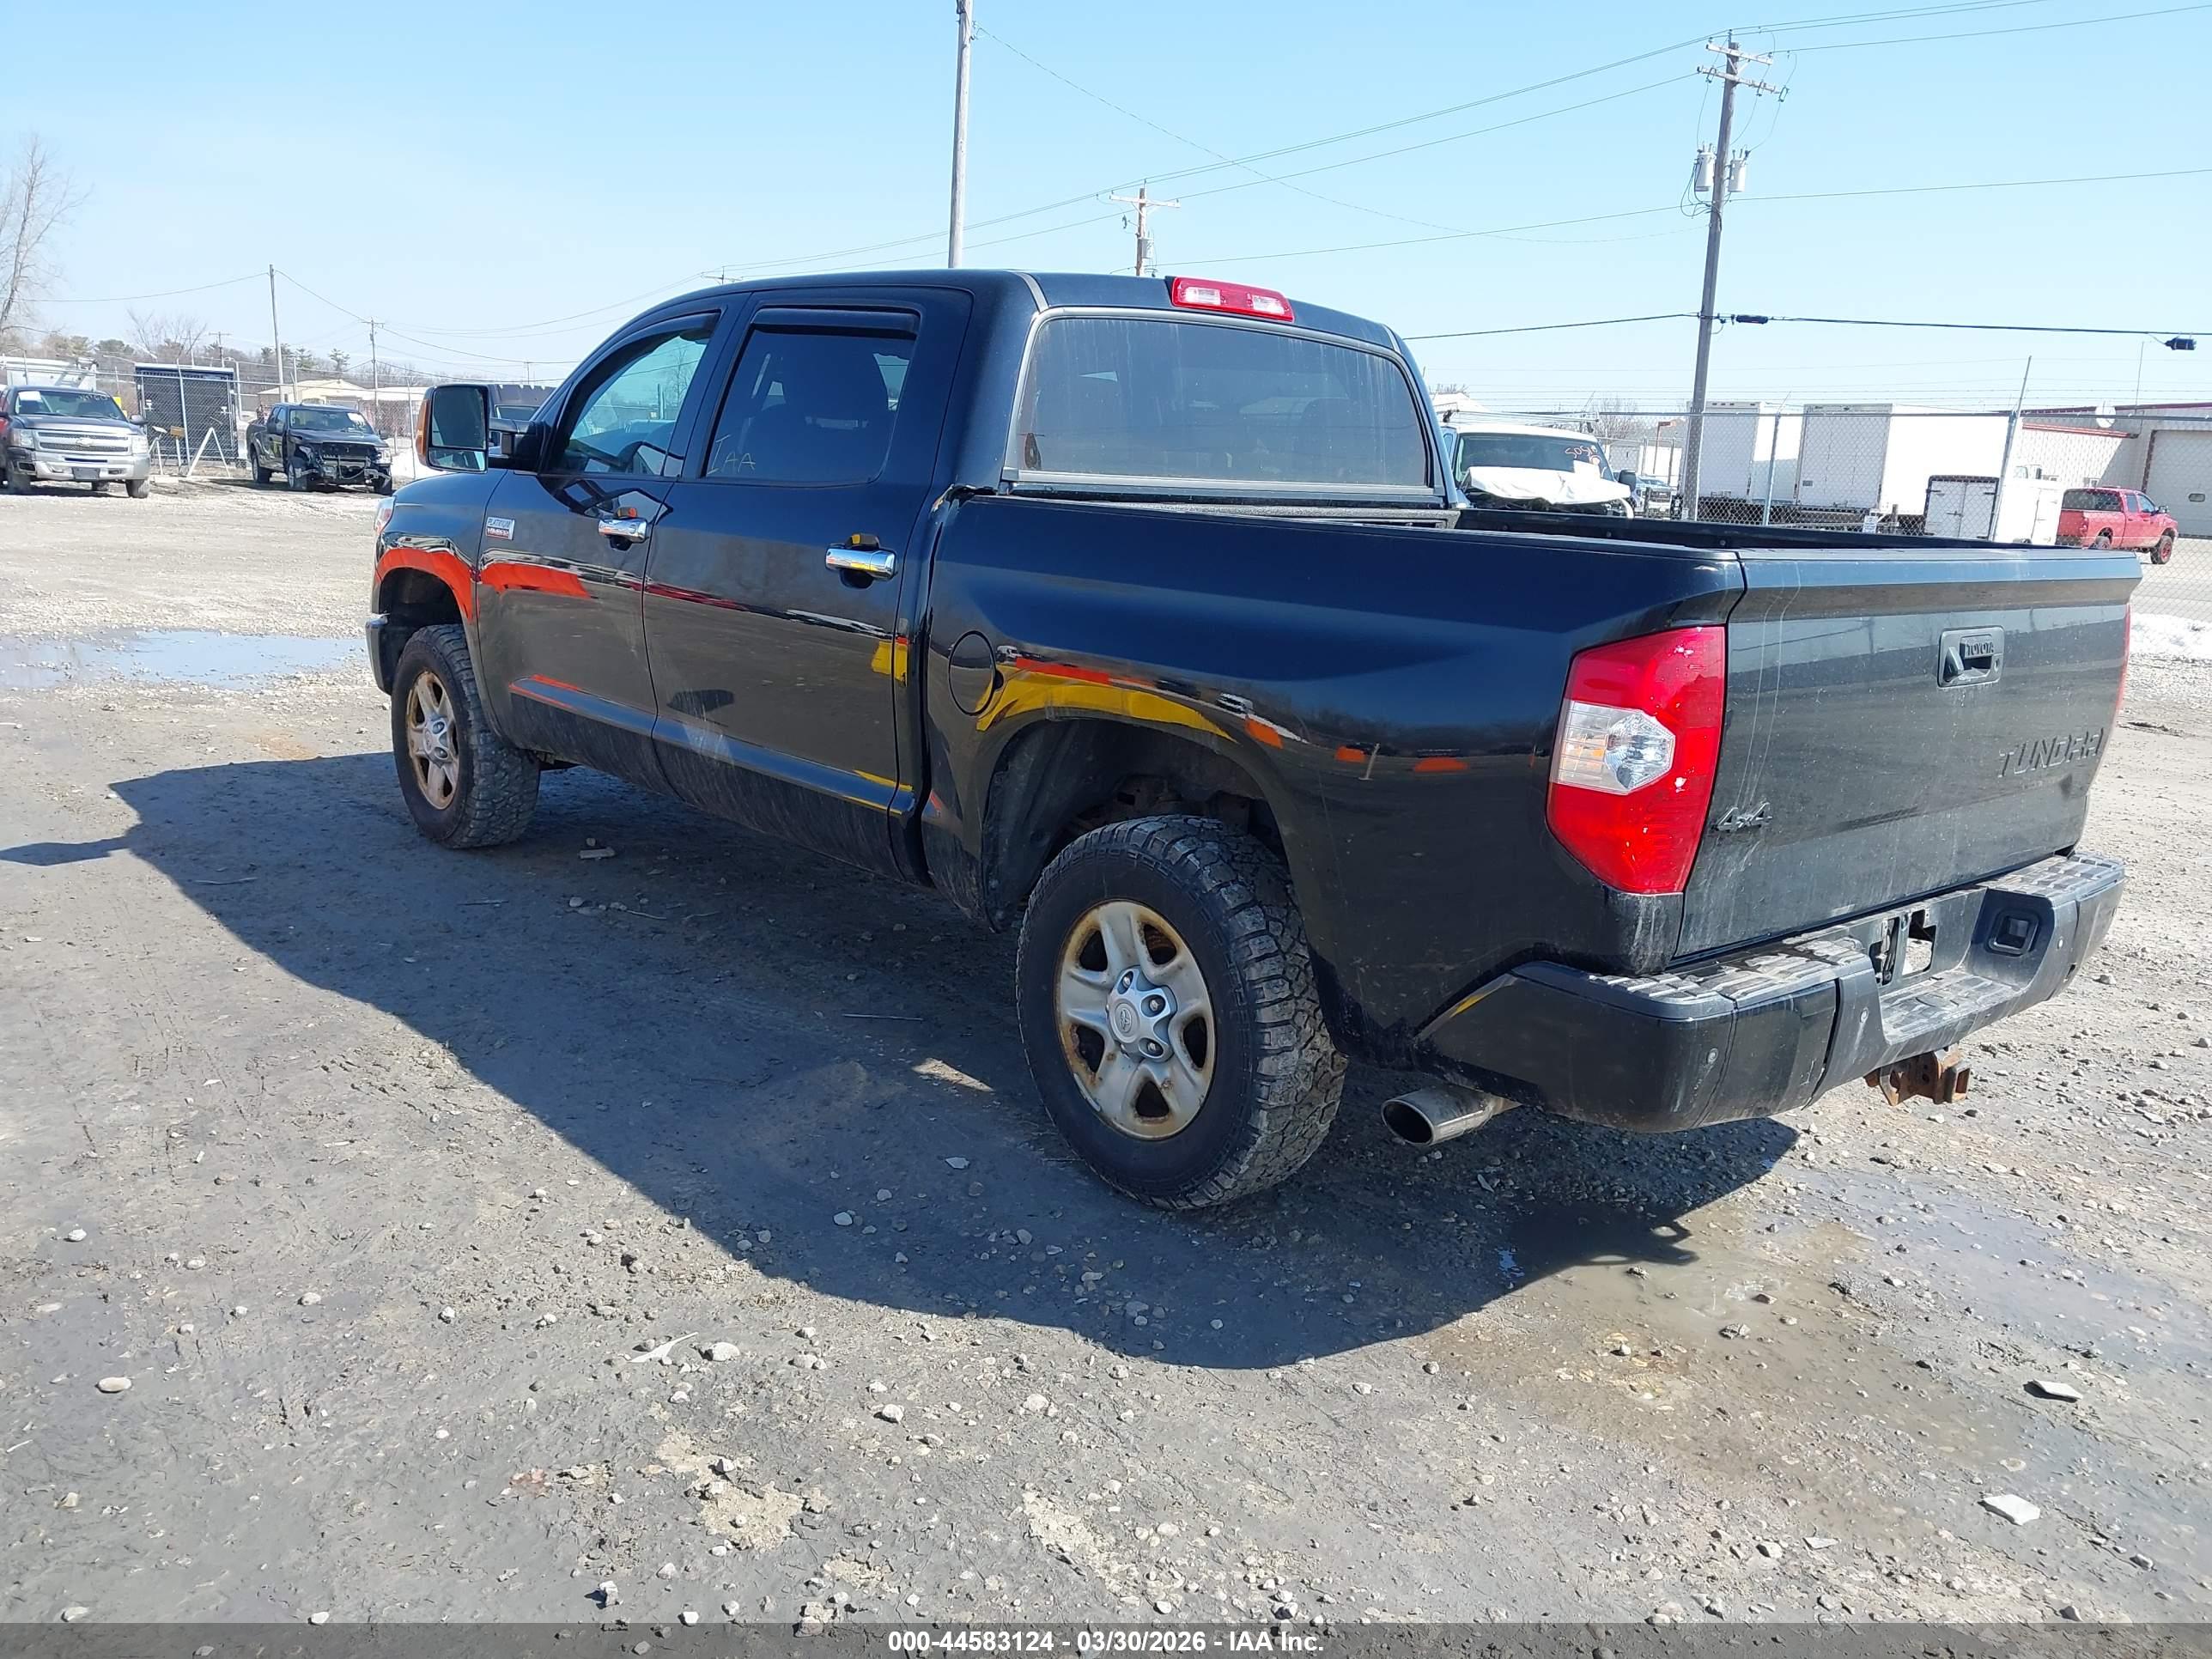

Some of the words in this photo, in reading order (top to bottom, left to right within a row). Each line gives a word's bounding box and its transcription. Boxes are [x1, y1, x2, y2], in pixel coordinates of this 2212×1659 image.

[708, 434, 756, 474] IAA
[1966, 641, 1994, 656] TOYOTA
[1997, 728, 2103, 778] TUNDRA
